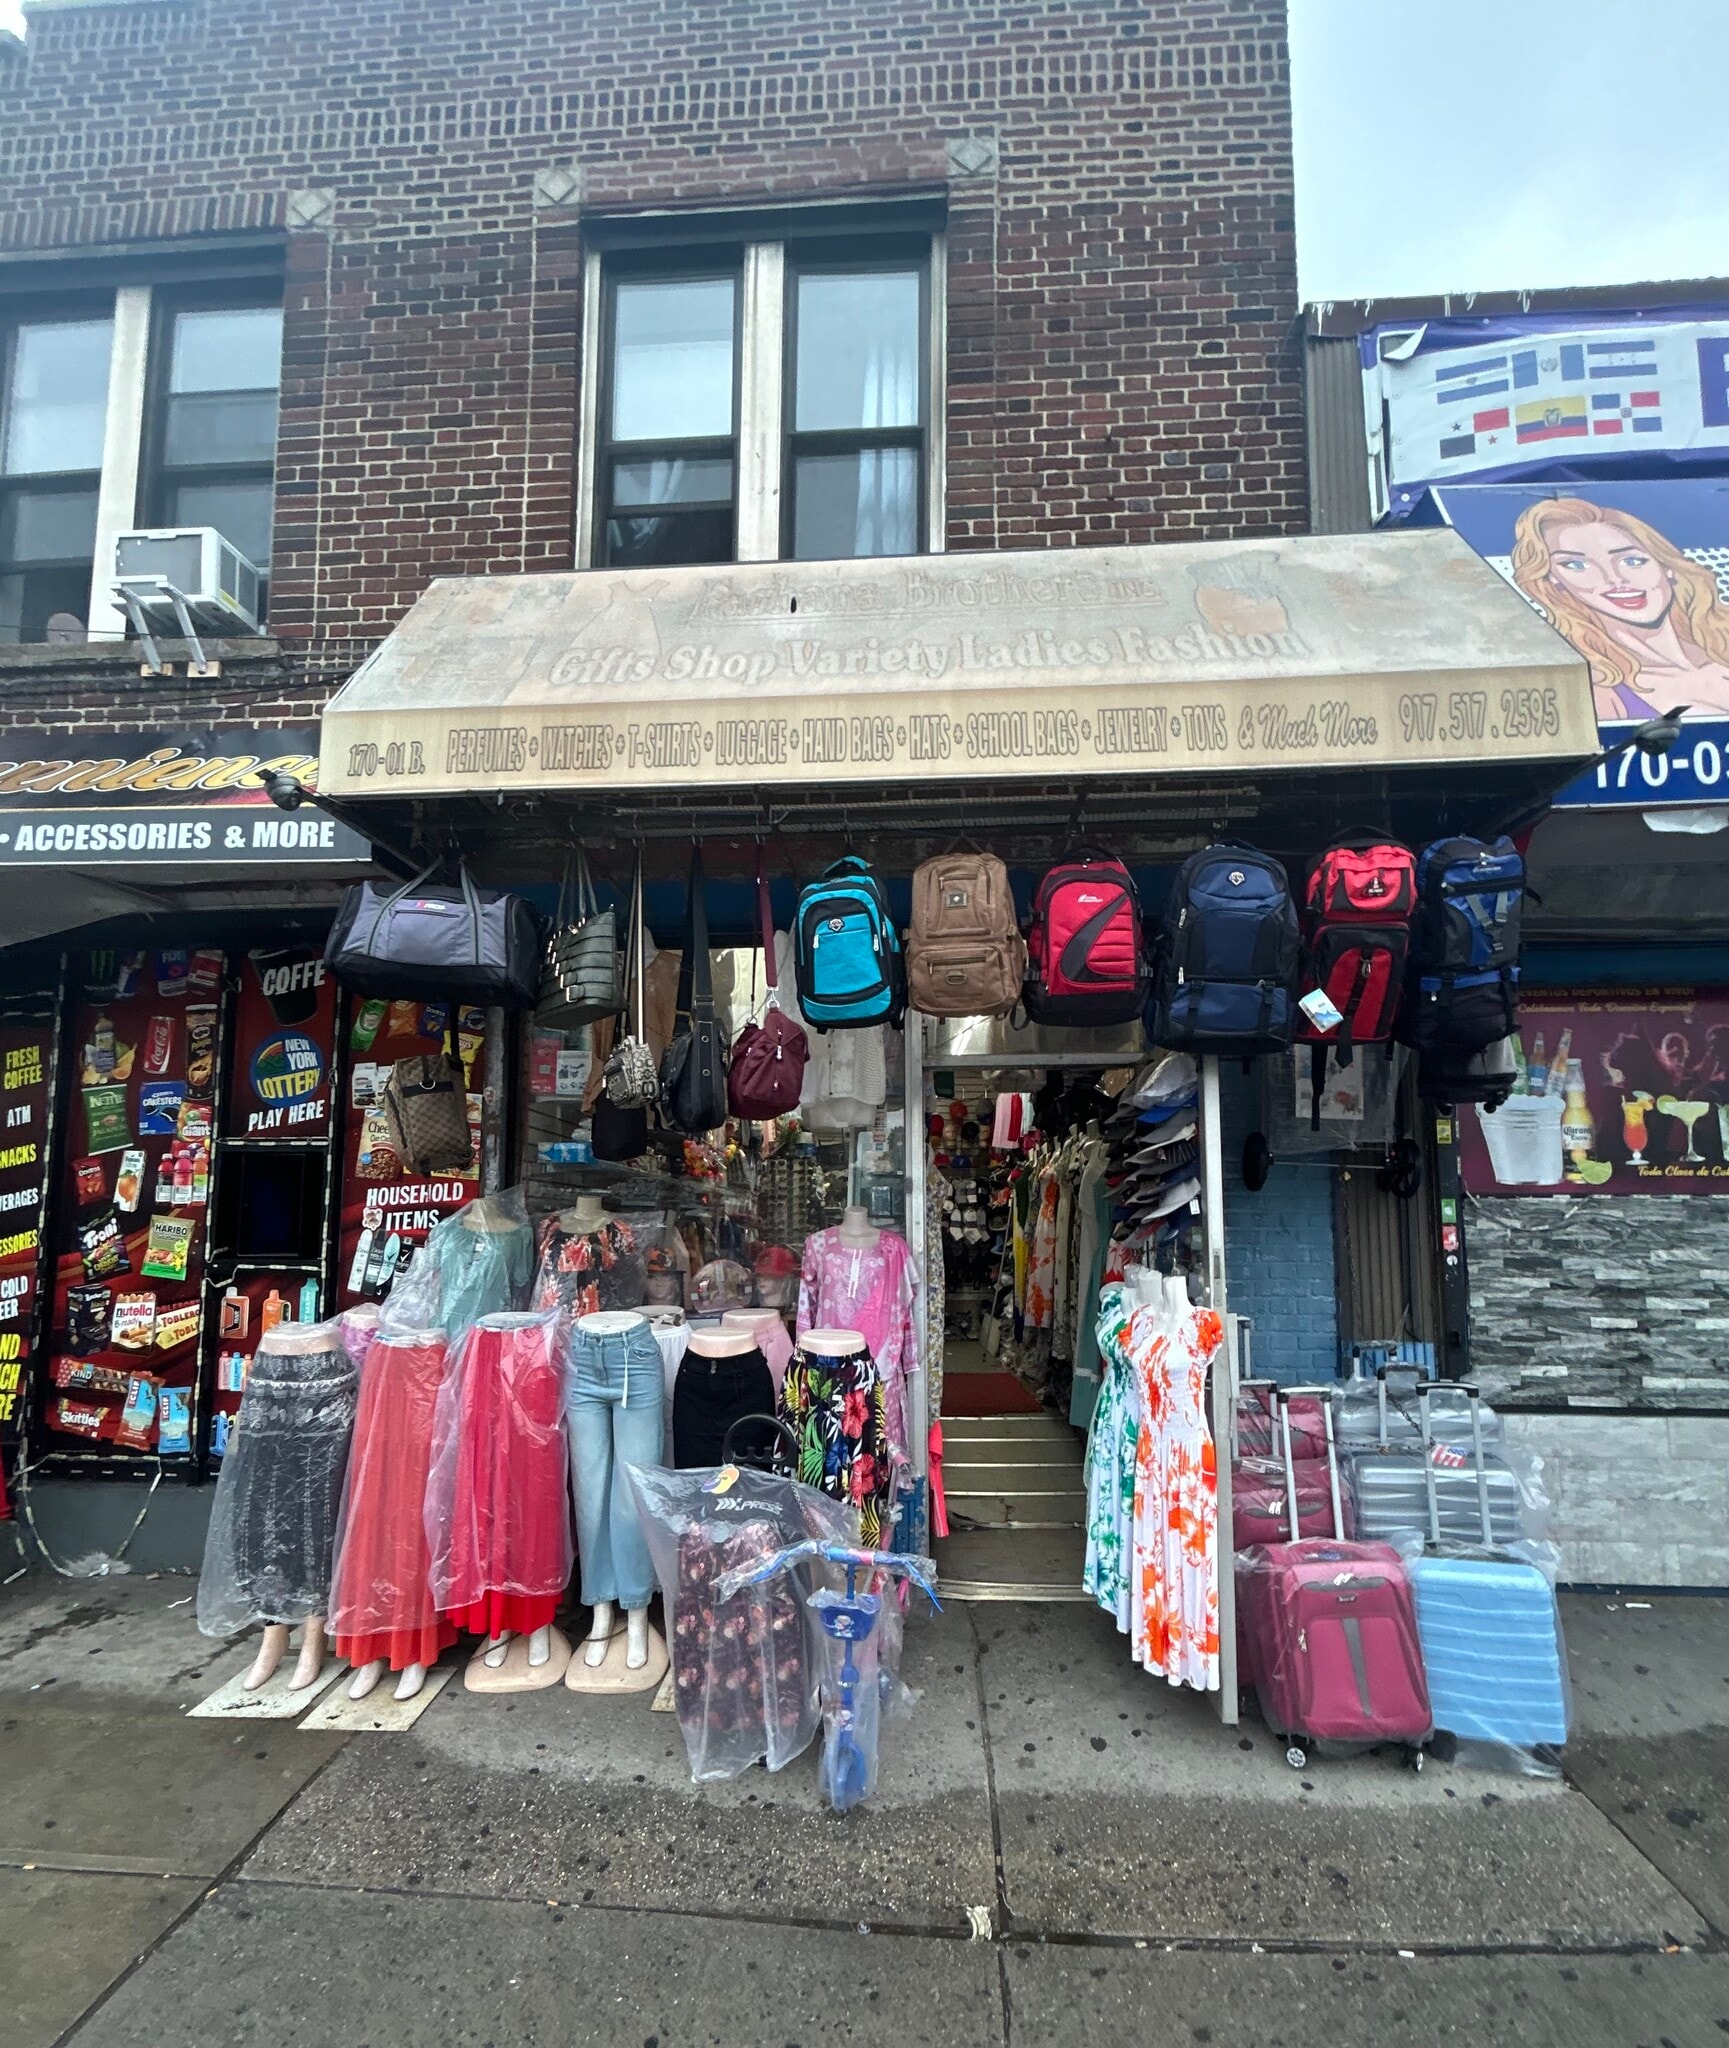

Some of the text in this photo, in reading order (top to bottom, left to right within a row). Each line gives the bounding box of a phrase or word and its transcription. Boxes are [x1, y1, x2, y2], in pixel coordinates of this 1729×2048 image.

[548, 621, 1314, 687] Gifts Shop Variety Ladies Fashion
[347, 742, 406, 777] 170-01
[446, 727, 526, 774] PERFUMES
[540, 725, 613, 771] WATCHES
[627, 721, 701, 768] T-SHIRTS
[716, 720, 787, 765] LUGGAGE
[802, 718, 847, 763] HAND
[850, 716, 895, 761] BAGS
[909, 714, 951, 760] HATS
[967, 711, 1033, 758] SCHOOL
[1035, 709, 1080, 756] BAGS
[1095, 707, 1168, 754] JEWELRY
[1182, 705, 1228, 751] TOYS
[1240, 705, 1255, 749] &
[1259, 703, 1320, 750] Much
[1320, 701, 1378, 748] More
[1399, 688, 1560, 742] 917.517.2595
[0, 747, 319, 794] enience
[1597, 740, 1729, 789] 170-0
[14, 821, 335, 851] ACCESSORIES & MORE
[6, 1045, 40, 1070] FRESH
[284, 1038, 310, 1052] NEW
[287, 1052, 318, 1071] YORK
[4, 1064, 43, 1090] COFFEE
[256, 1067, 321, 1099] LOTTERY
[6, 1105, 32, 1128] ATM
[248, 1100, 325, 1131] PLAY HERE
[366, 1182, 464, 1207] HOUSEHOLD
[155, 1223, 188, 1236] HARIBO
[385, 1209, 440, 1231] ITEMS
[82, 1218, 118, 1249] Trolli
[1, 1276, 28, 1299] COLD
[115, 1304, 153, 1318] nutella
[70, 1369, 92, 1380] KIND
[60, 1411, 101, 1428] Skittles
